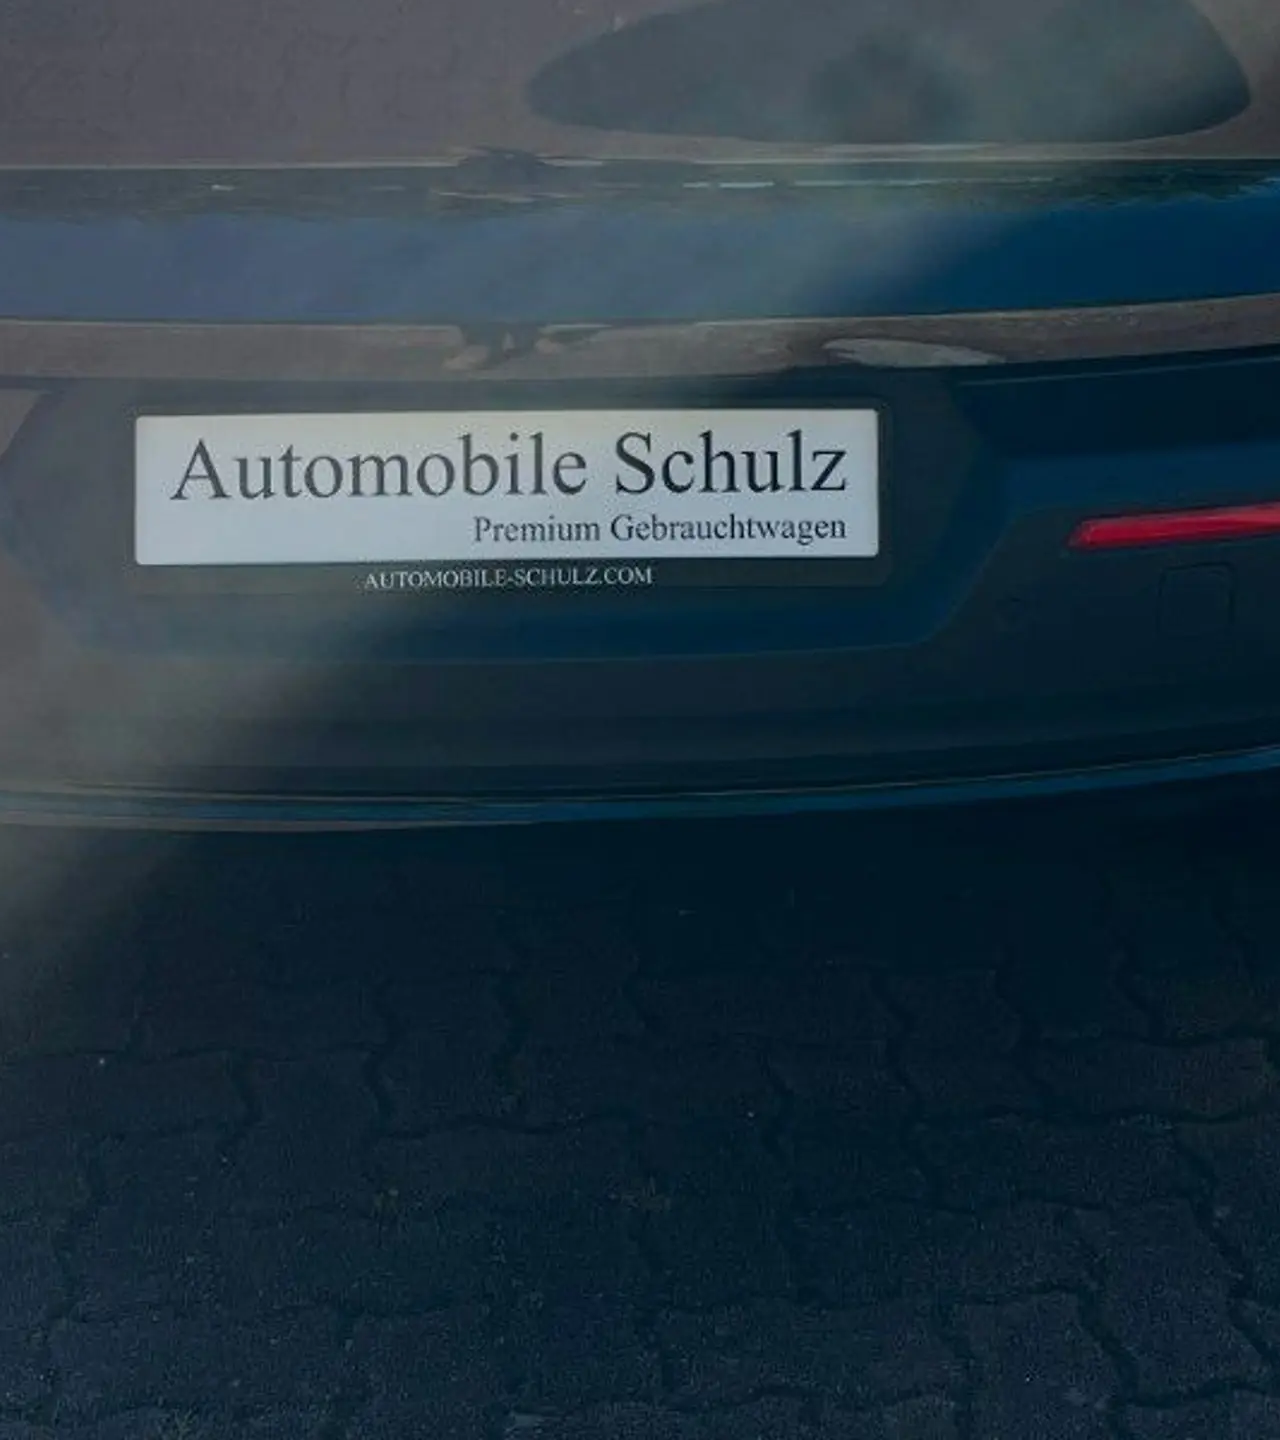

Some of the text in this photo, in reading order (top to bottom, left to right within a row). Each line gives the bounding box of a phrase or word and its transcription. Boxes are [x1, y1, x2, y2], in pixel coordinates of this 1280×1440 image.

[169, 428, 848, 501] Automobile Schulz
[472, 512, 848, 547] Premium Gebrauchtwagen
[363, 566, 654, 590] AUTOMOBILE-SCHULZ.COM
